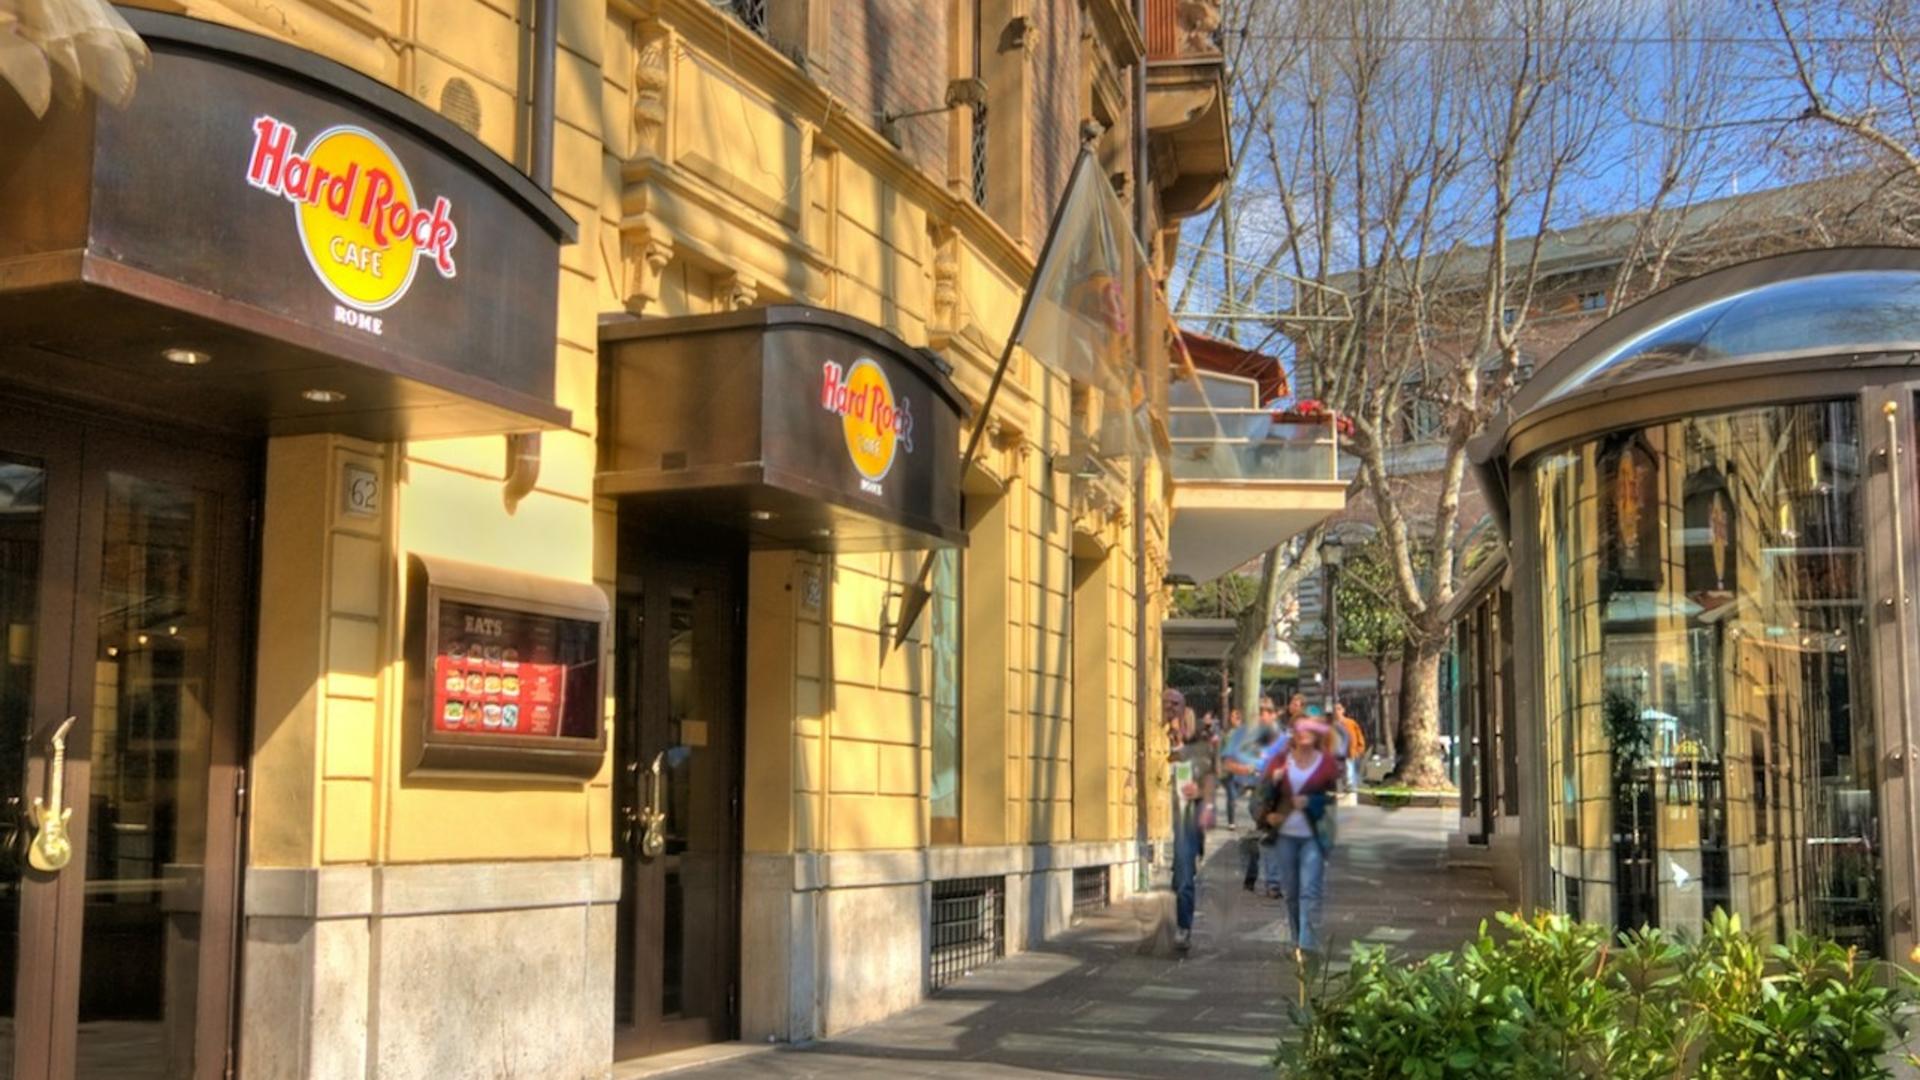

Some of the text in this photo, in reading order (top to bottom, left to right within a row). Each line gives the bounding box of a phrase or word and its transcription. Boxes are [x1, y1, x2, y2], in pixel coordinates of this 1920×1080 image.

[247, 115, 457, 278] Hard Rock
[329, 236, 384, 277] CAFE
[333, 304, 384, 335] ROME
[821, 360, 913, 453] Hard Rock
[352, 478, 378, 508] 62
[465, 615, 503, 636] EATS
